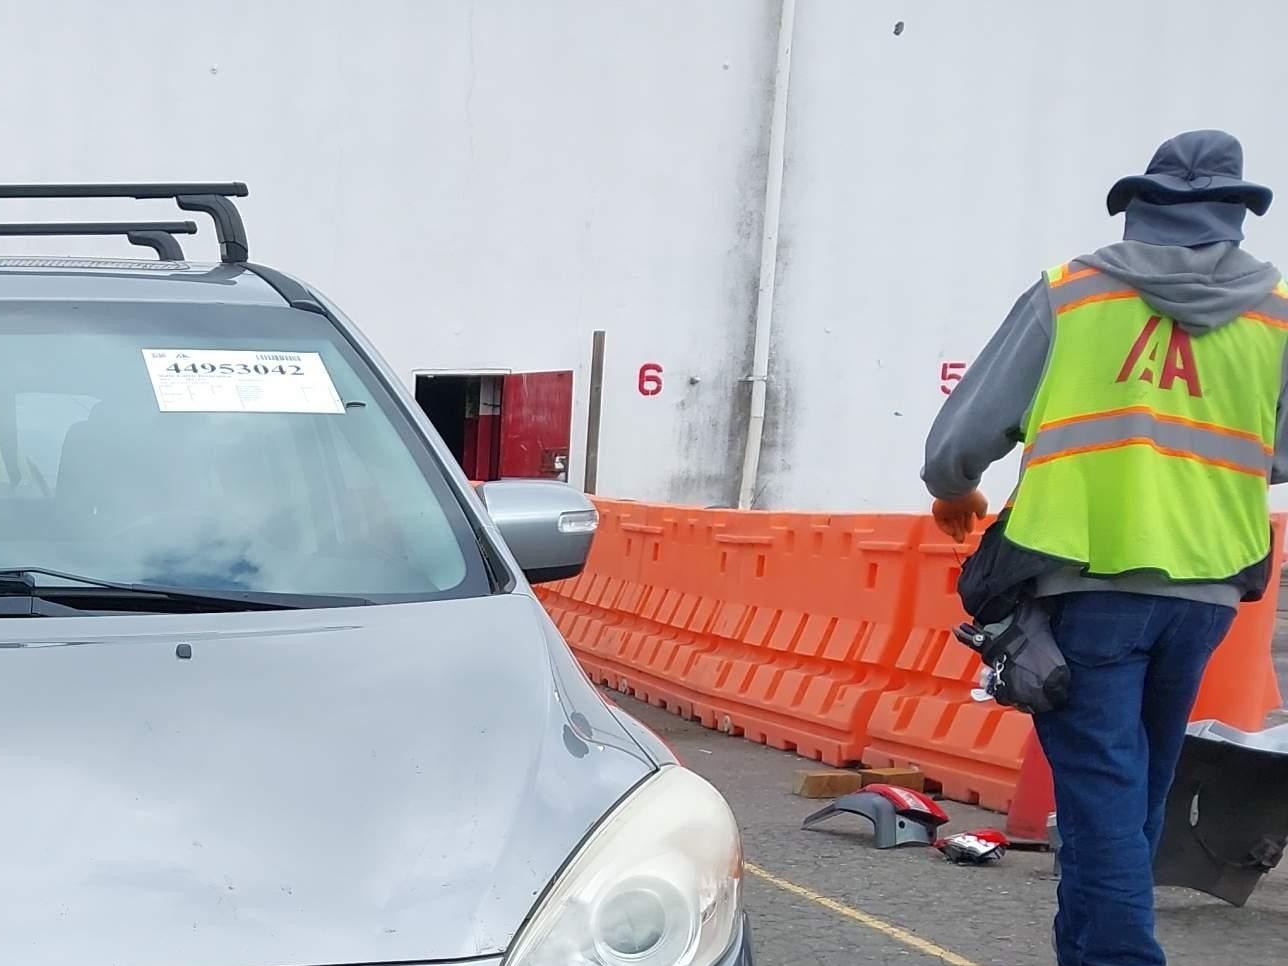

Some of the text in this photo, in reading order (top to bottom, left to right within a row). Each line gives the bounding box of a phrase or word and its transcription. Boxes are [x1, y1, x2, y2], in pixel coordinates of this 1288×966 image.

[166, 362, 305, 376] 44953042
[638, 363, 663, 396] 6
[940, 362, 967, 395] 5
